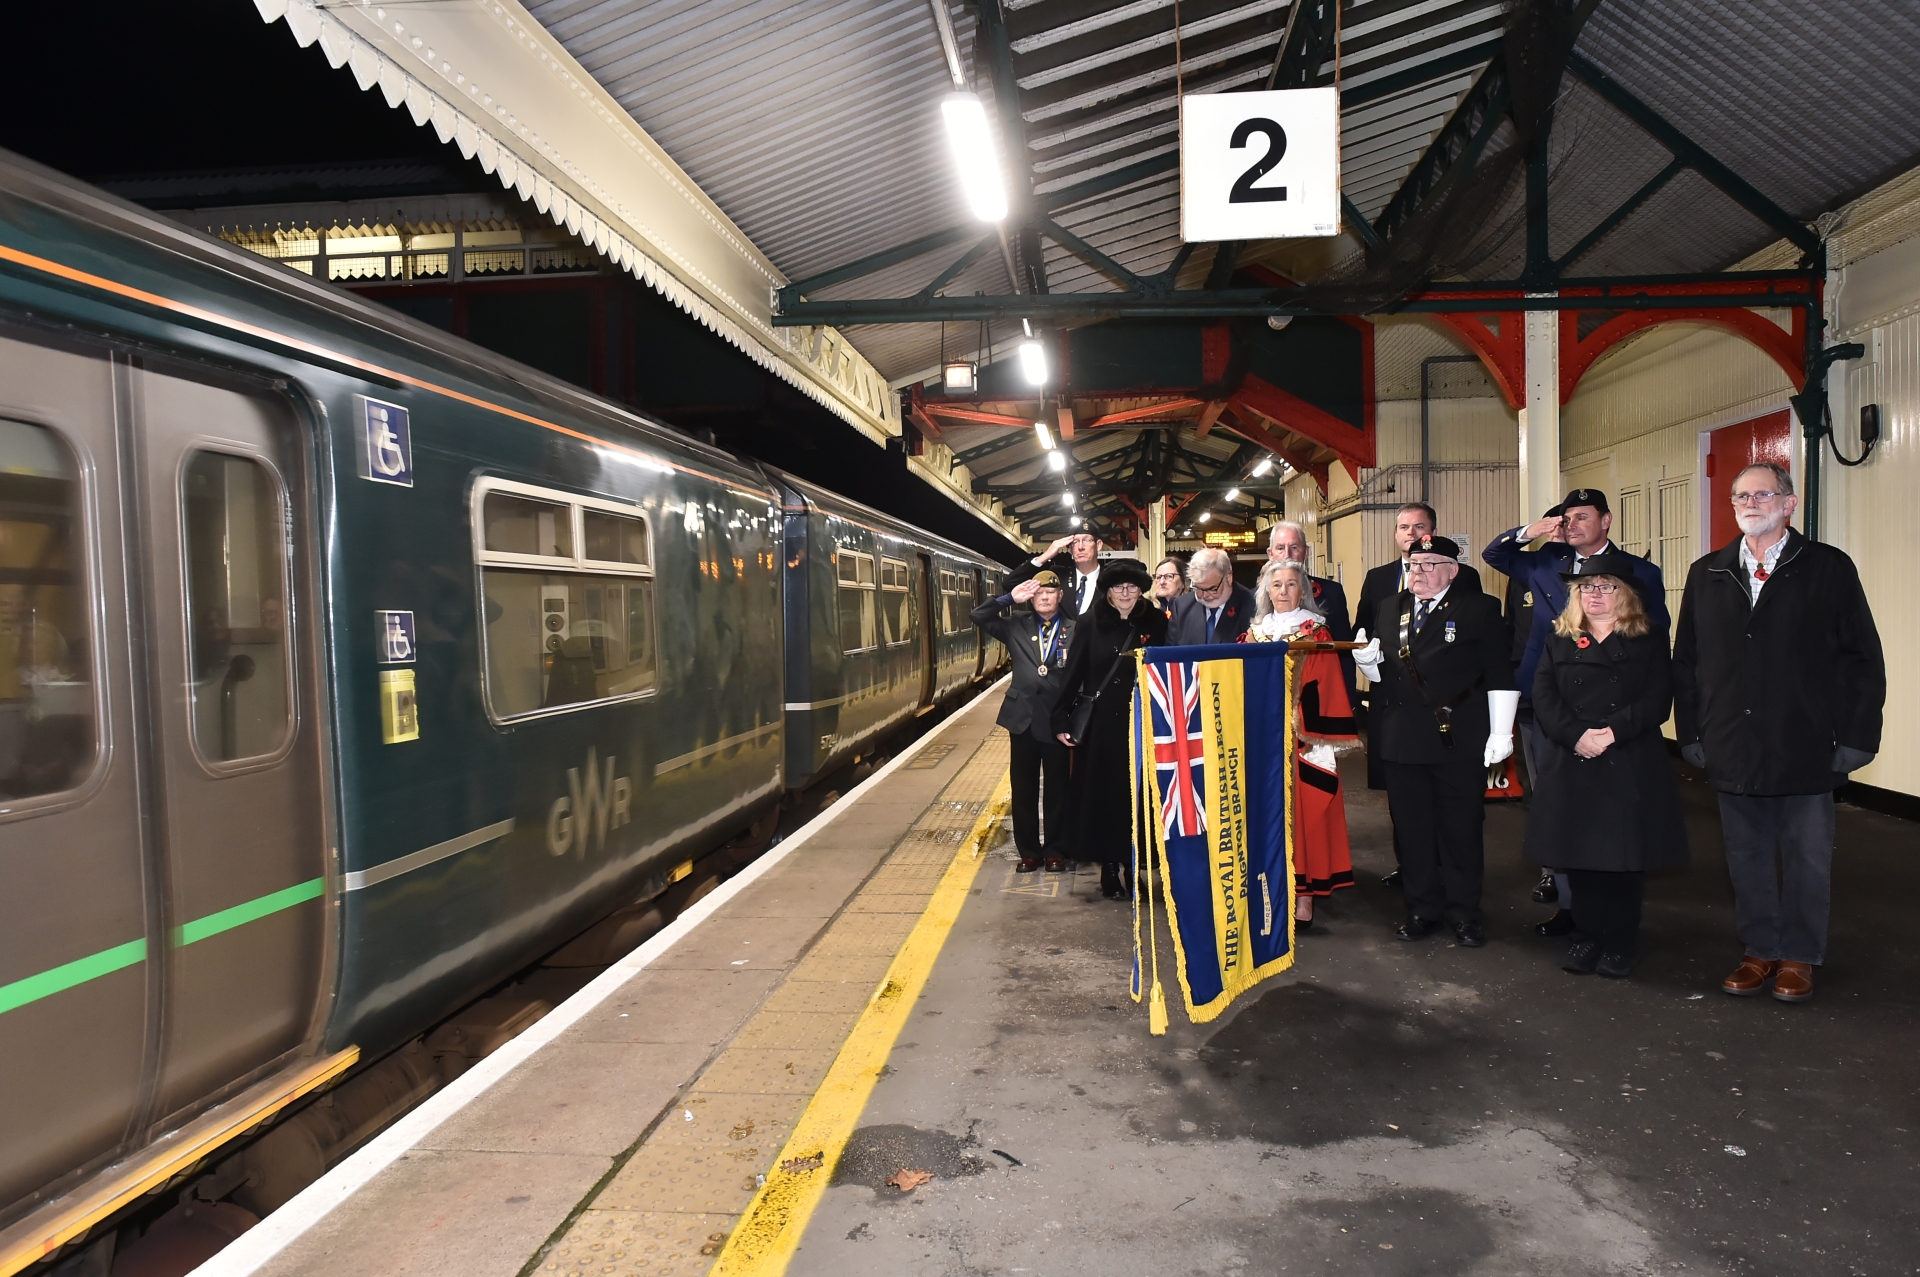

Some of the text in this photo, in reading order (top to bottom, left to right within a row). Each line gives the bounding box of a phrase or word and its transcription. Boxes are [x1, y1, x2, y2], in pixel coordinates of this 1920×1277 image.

[1228, 117, 1288, 204] 2
[547, 745, 632, 861] GWR
[1211, 681, 1239, 972] THE ROYAL BRITISH LEGION
[1228, 747, 1248, 899] PAIGNTON BRANCH
